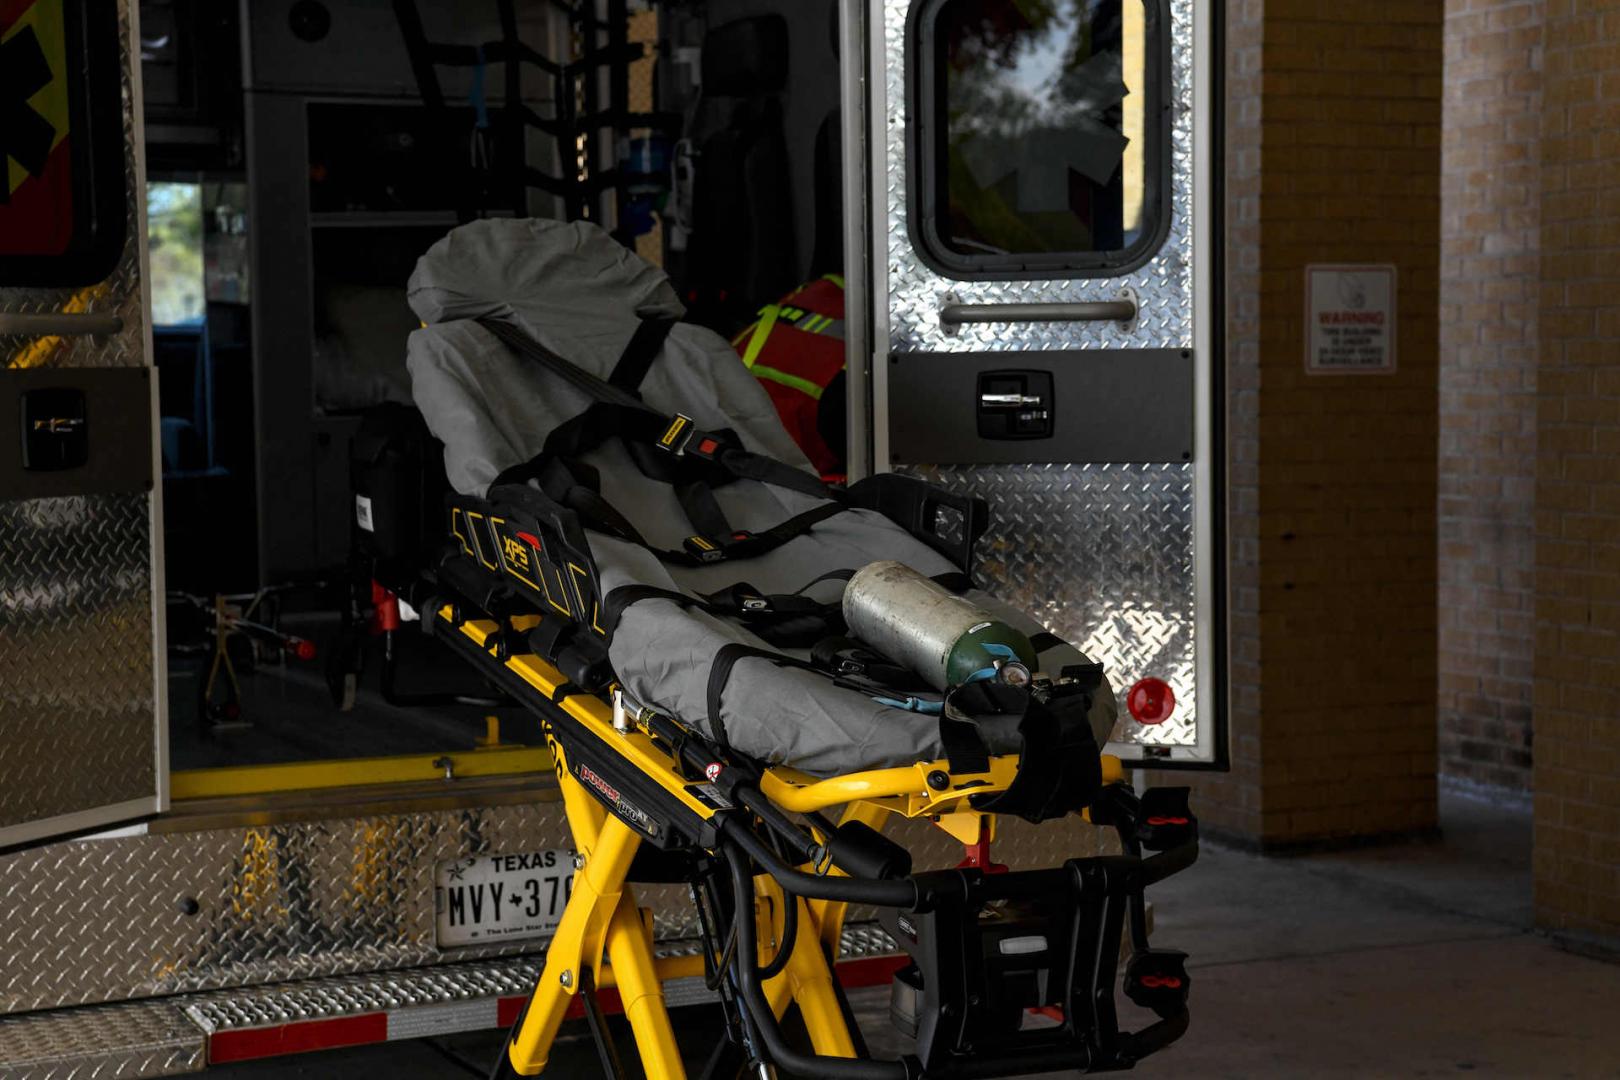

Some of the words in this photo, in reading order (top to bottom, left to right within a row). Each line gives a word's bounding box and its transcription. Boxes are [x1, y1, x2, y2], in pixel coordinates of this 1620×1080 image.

[502, 535, 529, 566] XPS
[491, 851, 556, 873] TEXAS
[448, 882, 504, 927] MVY
